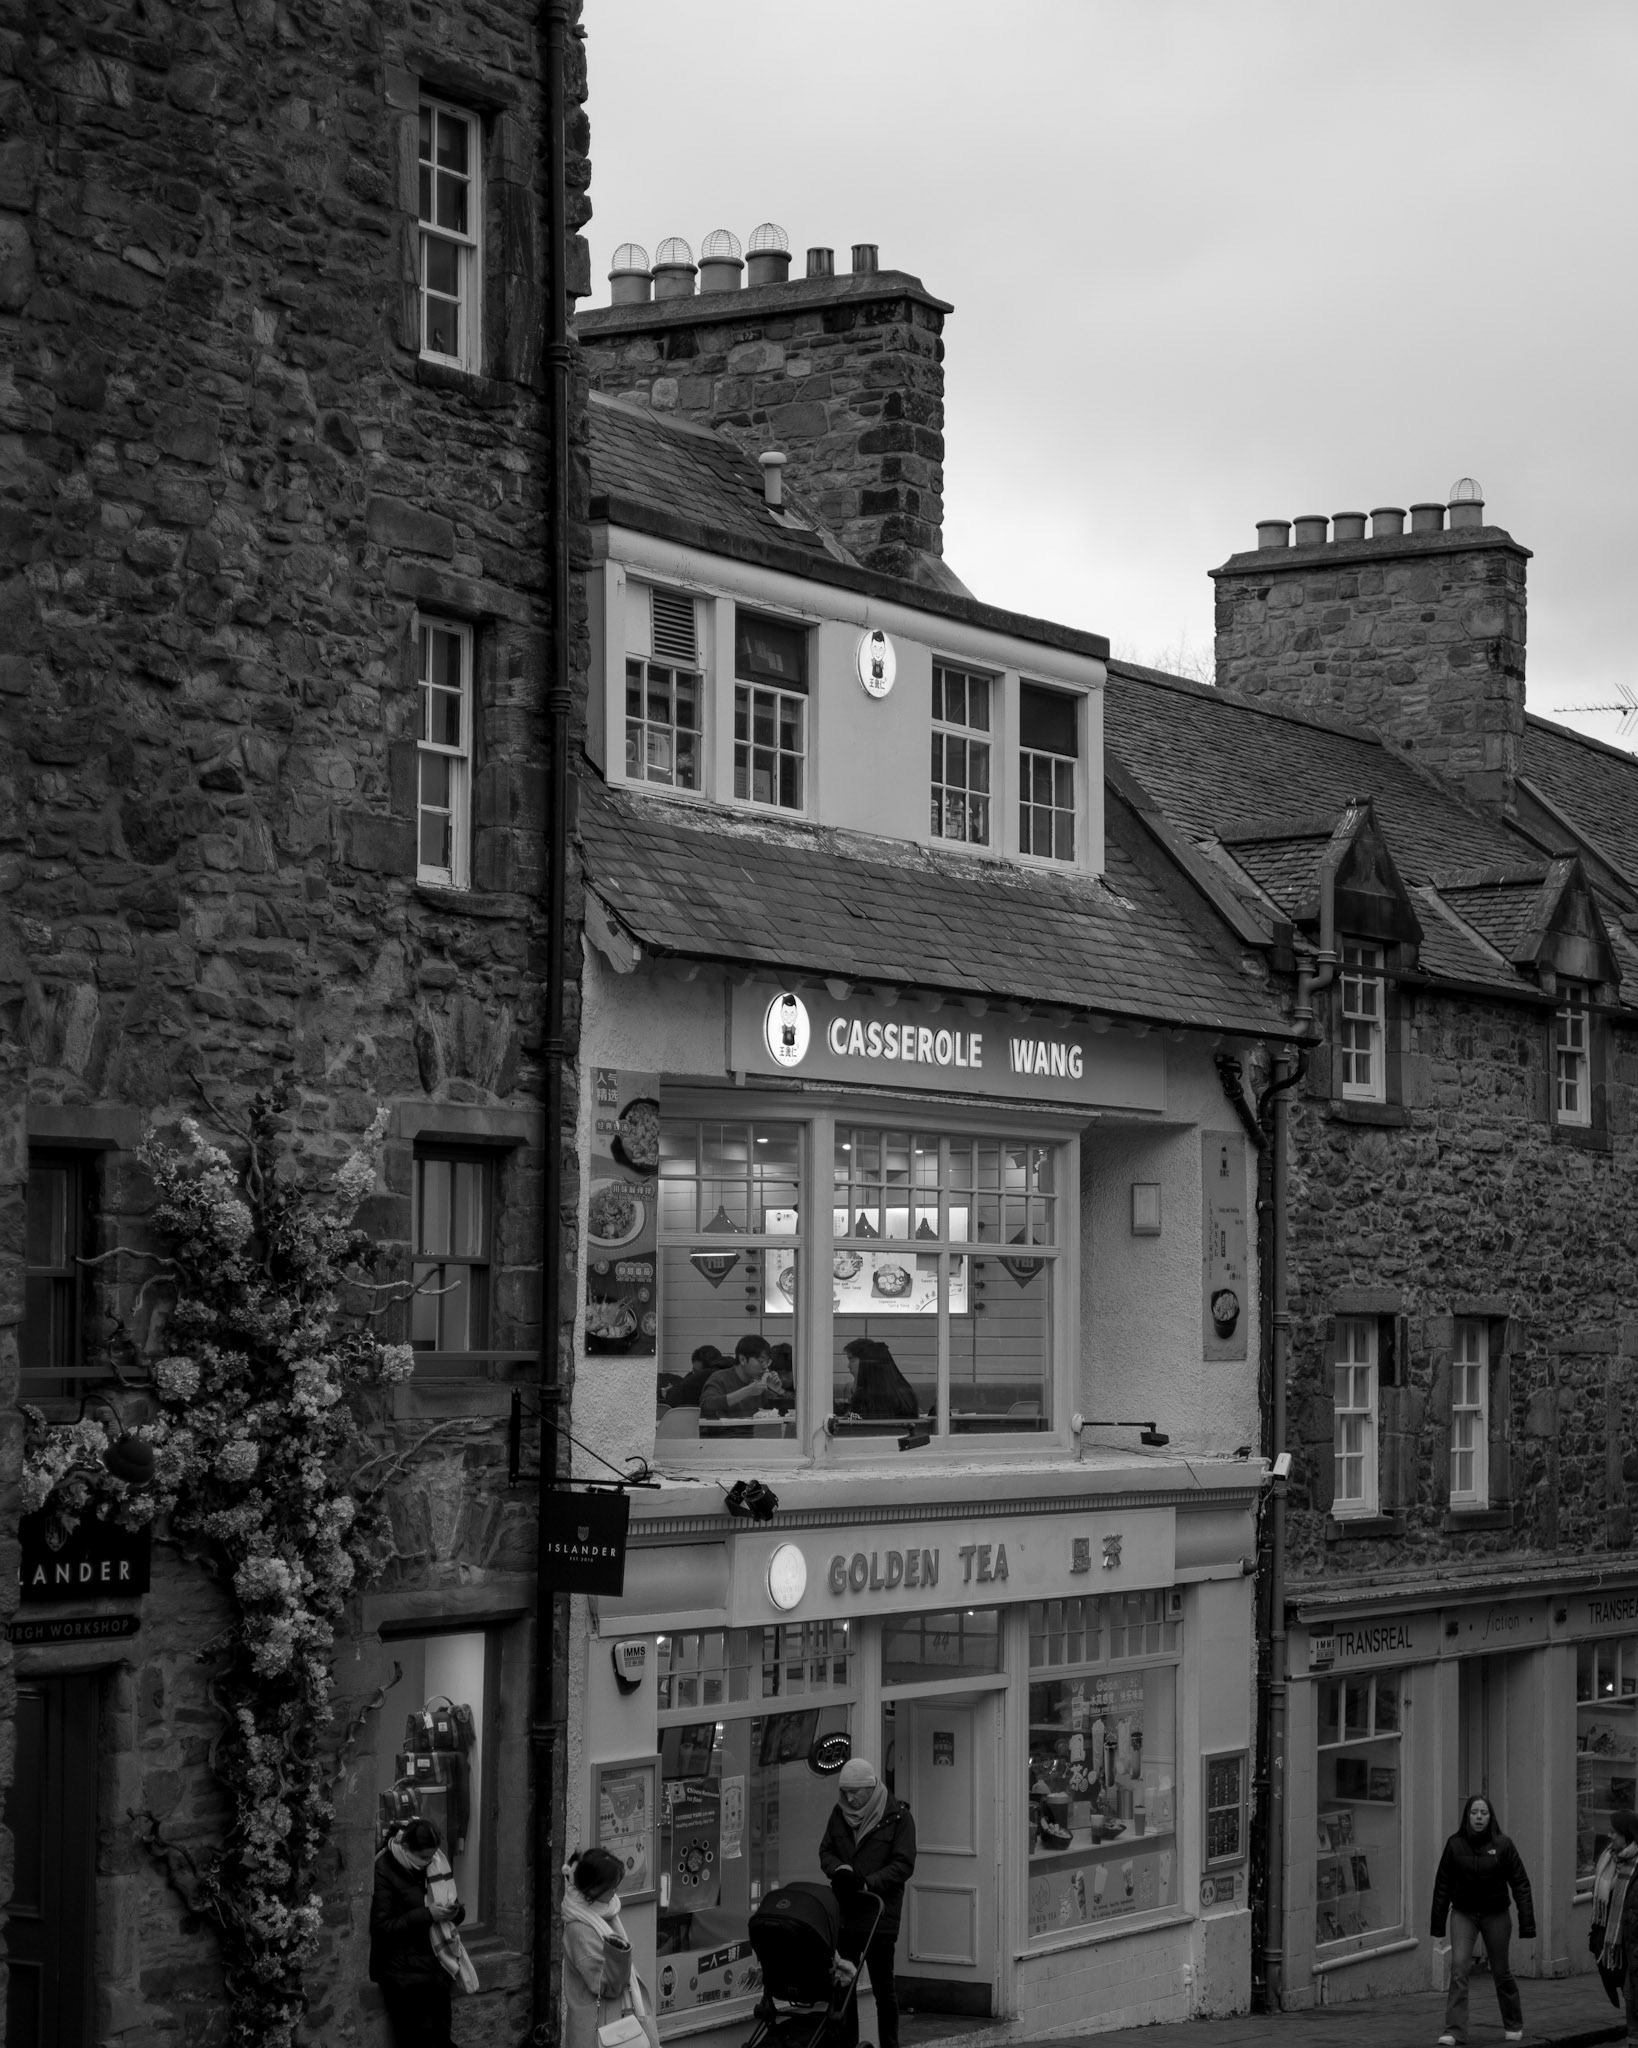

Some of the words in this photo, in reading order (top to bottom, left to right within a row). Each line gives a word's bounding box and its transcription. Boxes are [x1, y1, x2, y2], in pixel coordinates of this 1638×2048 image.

[828, 1017, 983, 1069] CASSEROLE
[1010, 1038, 1083, 1080] WANG
[597, 1071, 618, 1086] 人气
[597, 1087, 618, 1102] 精选
[597, 1121, 629, 1132] 经典汤
[548, 1543, 616, 1557] ISLANDER
[829, 1548, 940, 1595] GOLDEN
[959, 1543, 1009, 1584] TEA
[50, 1619, 129, 1637] WORKSHOP
[1482, 1608, 1520, 1640] fiction
[1336, 1625, 1413, 1657] TRANSREAL
[623, 1646, 646, 1657] IMMS
[816, 1744, 849, 1762] OPEN
